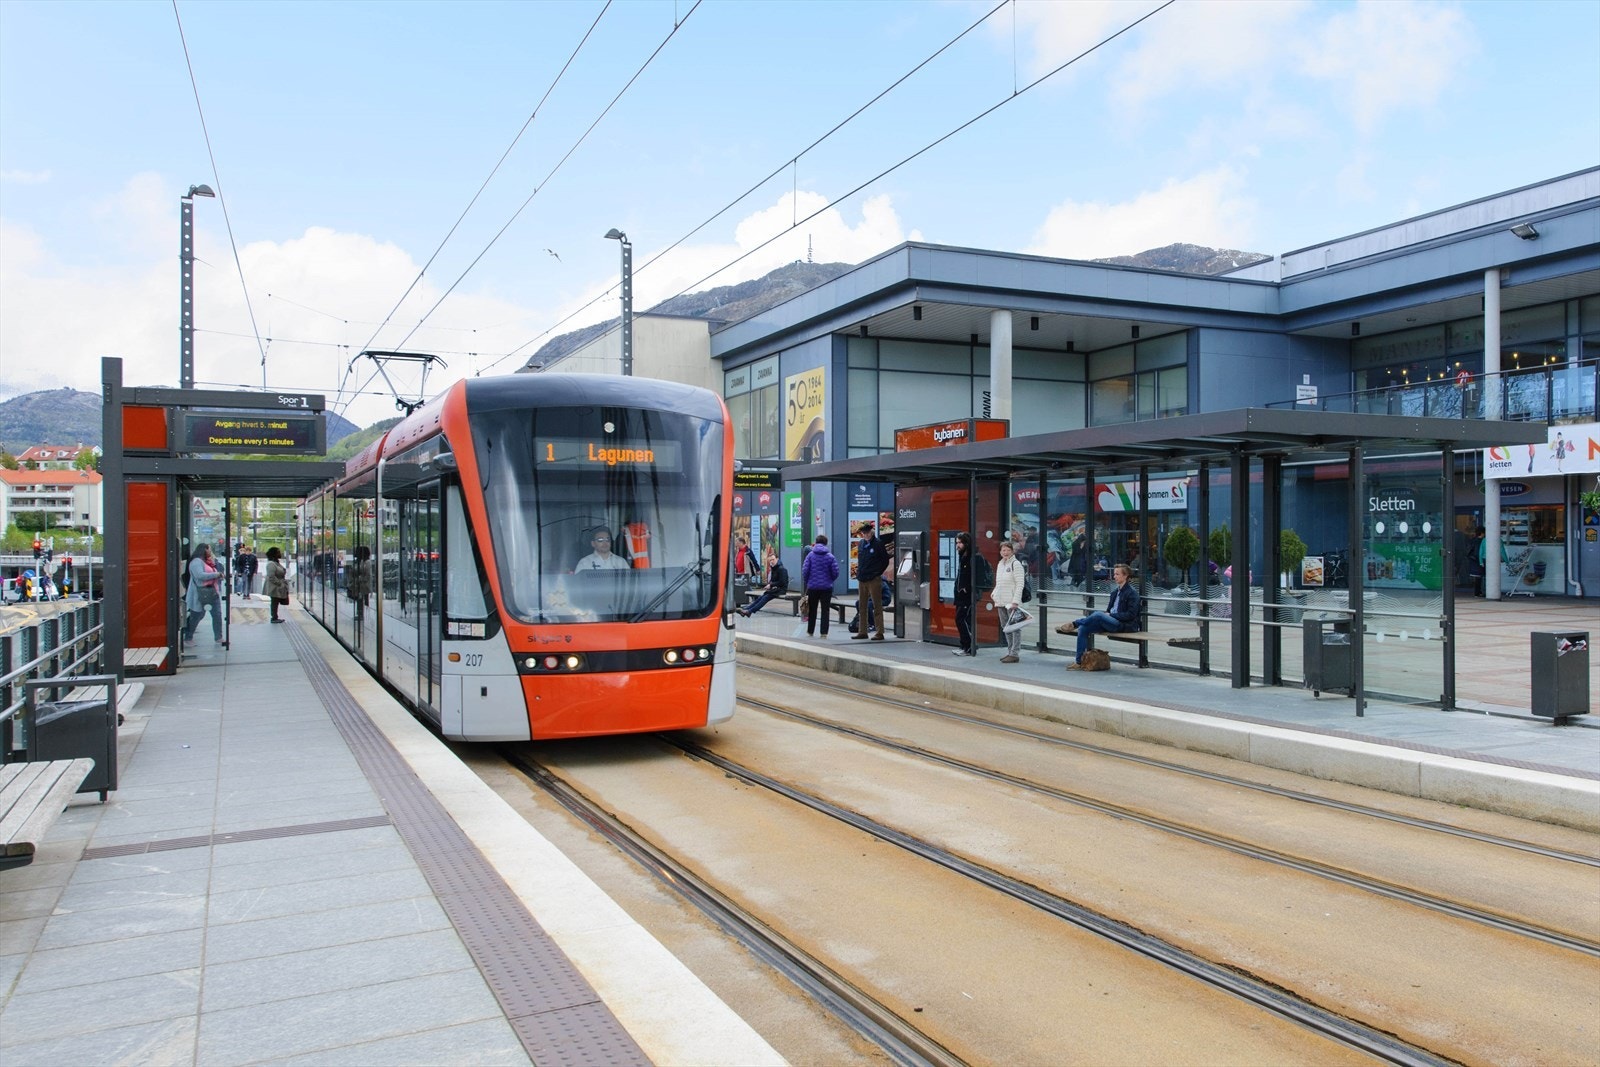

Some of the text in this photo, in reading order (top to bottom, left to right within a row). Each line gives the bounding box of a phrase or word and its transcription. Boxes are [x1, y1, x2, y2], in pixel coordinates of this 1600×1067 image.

[808, 375, 822, 388] 1964
[278, 395, 299, 405] Spor
[300, 397, 309, 408] 1
[787, 379, 808, 427] 50
[807, 394, 822, 409] 2014
[215, 420, 241, 429] Avgang
[208, 436, 243, 446] Departure
[243, 438, 263, 447] every
[268, 438, 295, 446] minutes
[933, 427, 964, 443] bybanen
[545, 442, 654, 466] 1 Lagunen
[1489, 460, 1513, 469] sletten
[1017, 490, 1041, 501] MEN
[1368, 496, 1416, 512] Sletten
[898, 508, 917, 519] Sletten
[1415, 555, 1432, 564] 2 for
[465, 653, 484, 667] 207
